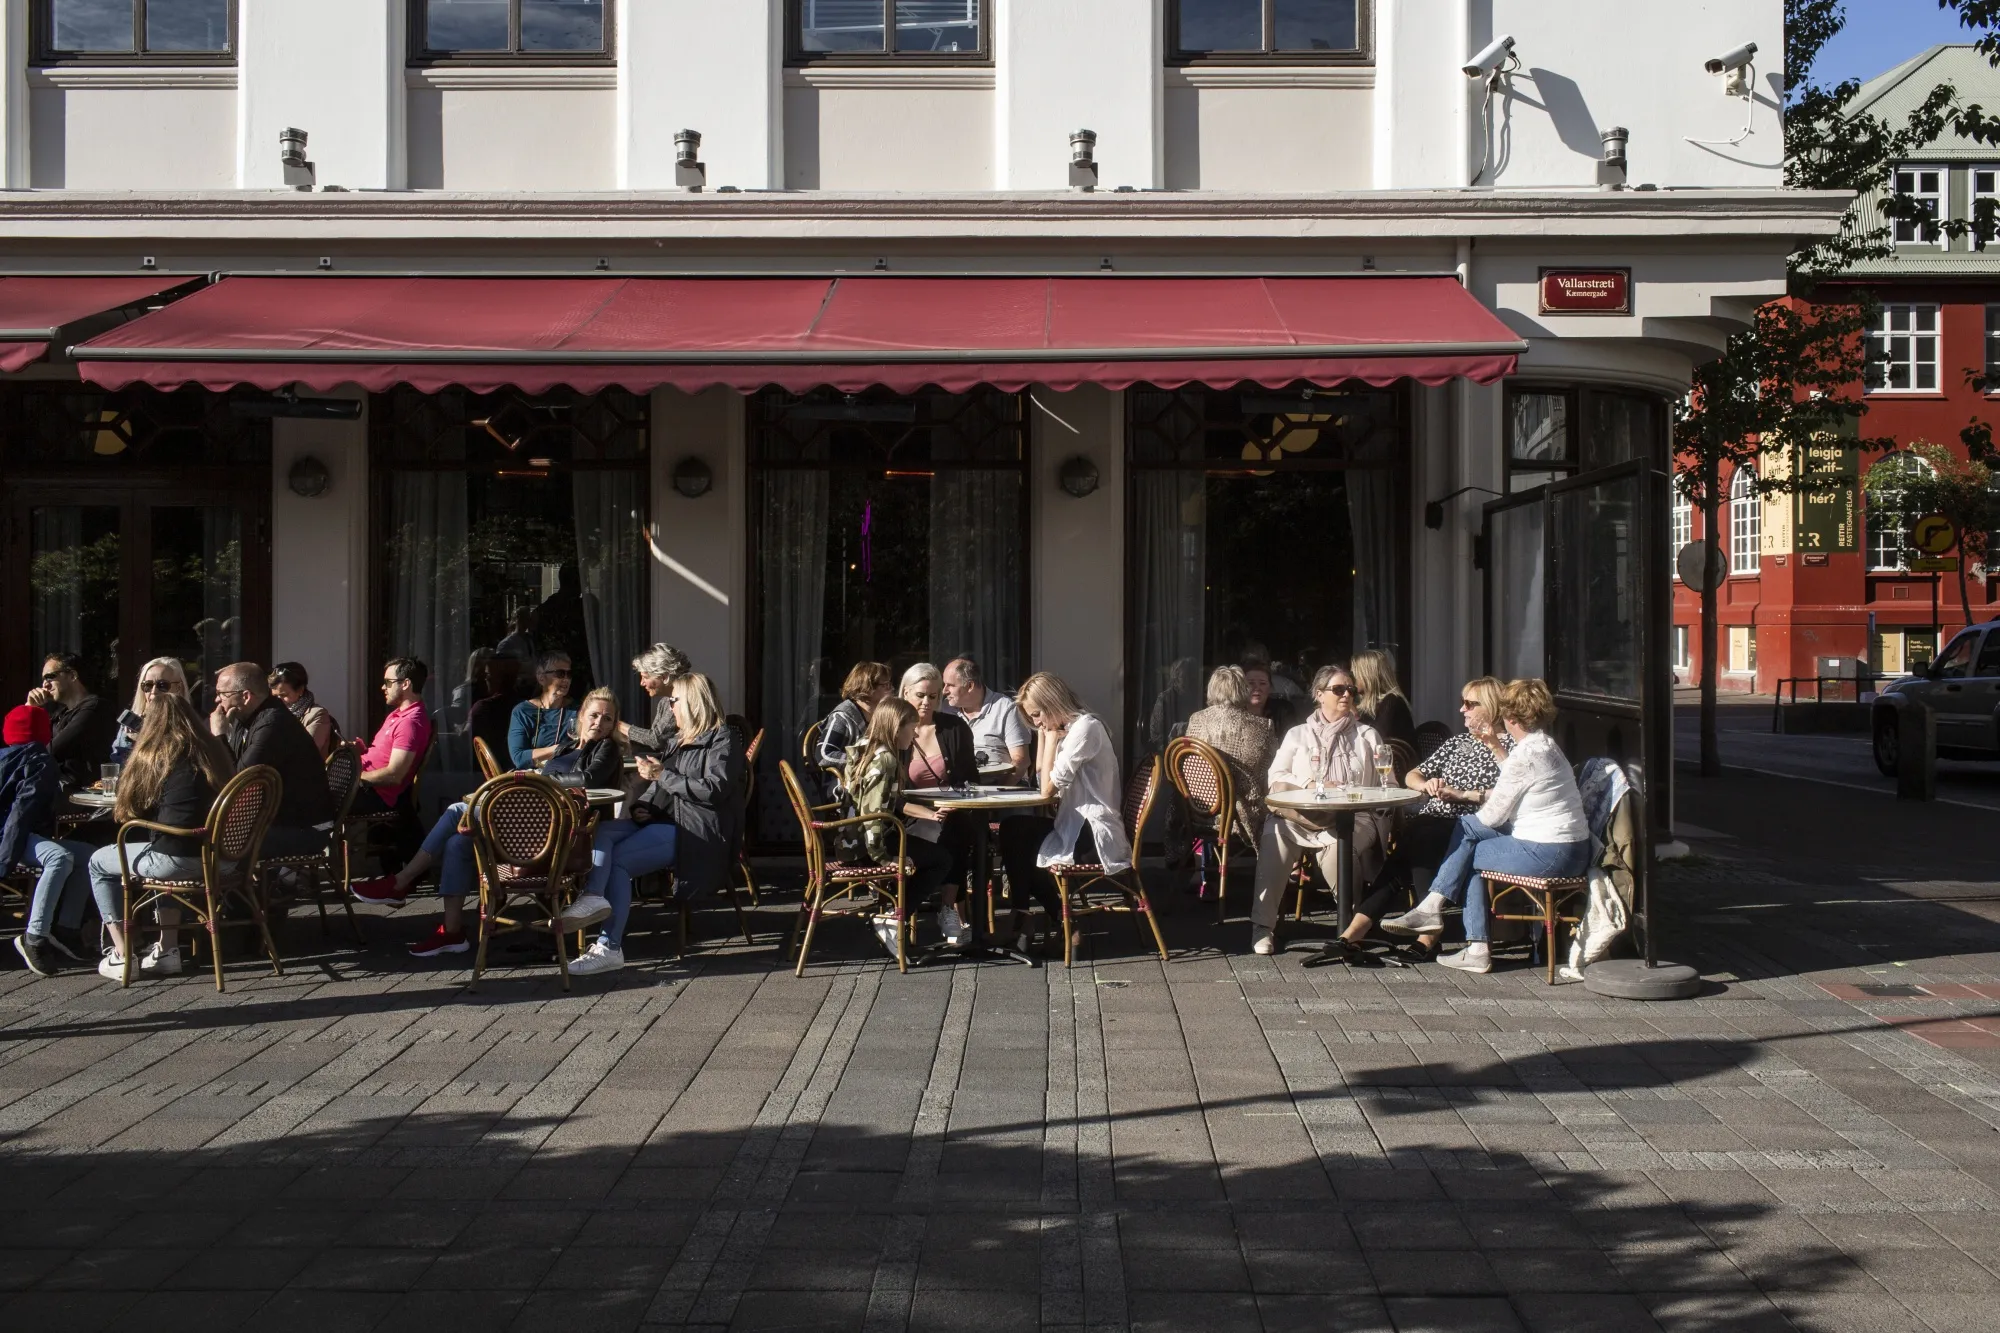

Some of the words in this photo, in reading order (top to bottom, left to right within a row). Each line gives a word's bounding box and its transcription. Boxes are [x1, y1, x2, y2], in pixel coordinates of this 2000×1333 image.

[1557, 278, 1615, 288] Vallarstræti
[1566, 290, 1608, 298] Kæmnergade
[1809, 447, 1842, 460] leigja
[1809, 492, 1836, 504] hér?
[1845, 489, 1853, 547] FASTEIGNAFÉLAG
